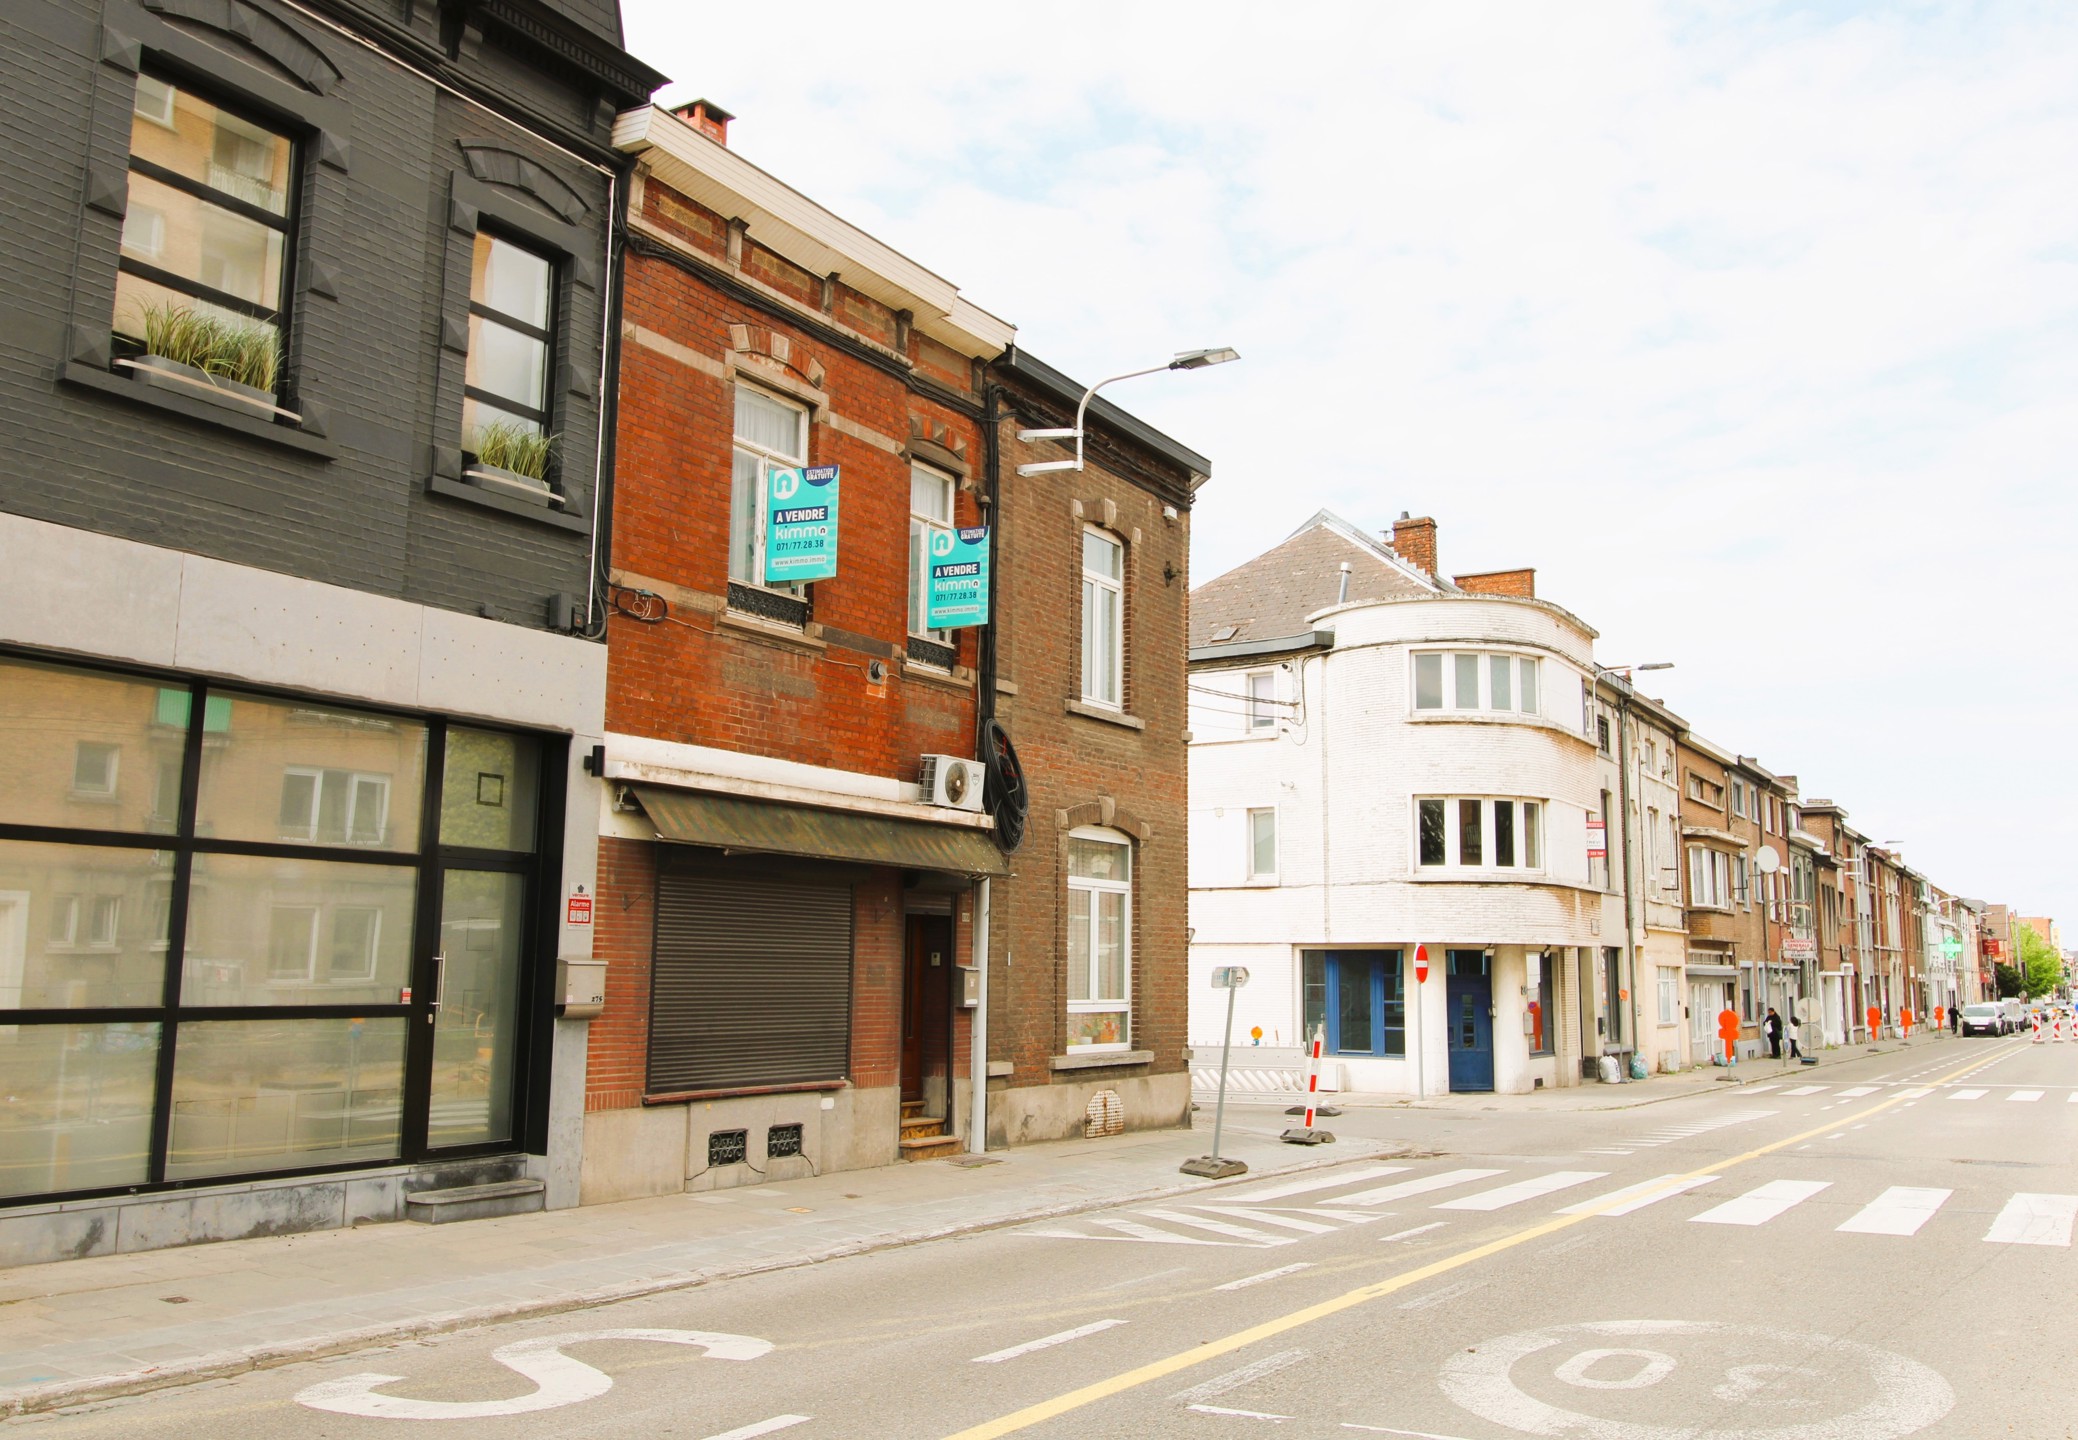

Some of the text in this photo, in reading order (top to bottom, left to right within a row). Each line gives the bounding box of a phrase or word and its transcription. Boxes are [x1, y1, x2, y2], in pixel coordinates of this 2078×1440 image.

[806, 472, 834, 481] GRATUITE
[776, 508, 825, 523] A VENDRE
[775, 525, 828, 540] kimmo
[776, 540, 824, 551] 071/77.28.38
[774, 556, 826, 566] www.kimmo.immo
[935, 564, 978, 577] A VENDRE
[934, 579, 980, 592] kimmo
[935, 592, 977, 602] 071/77.28.38
